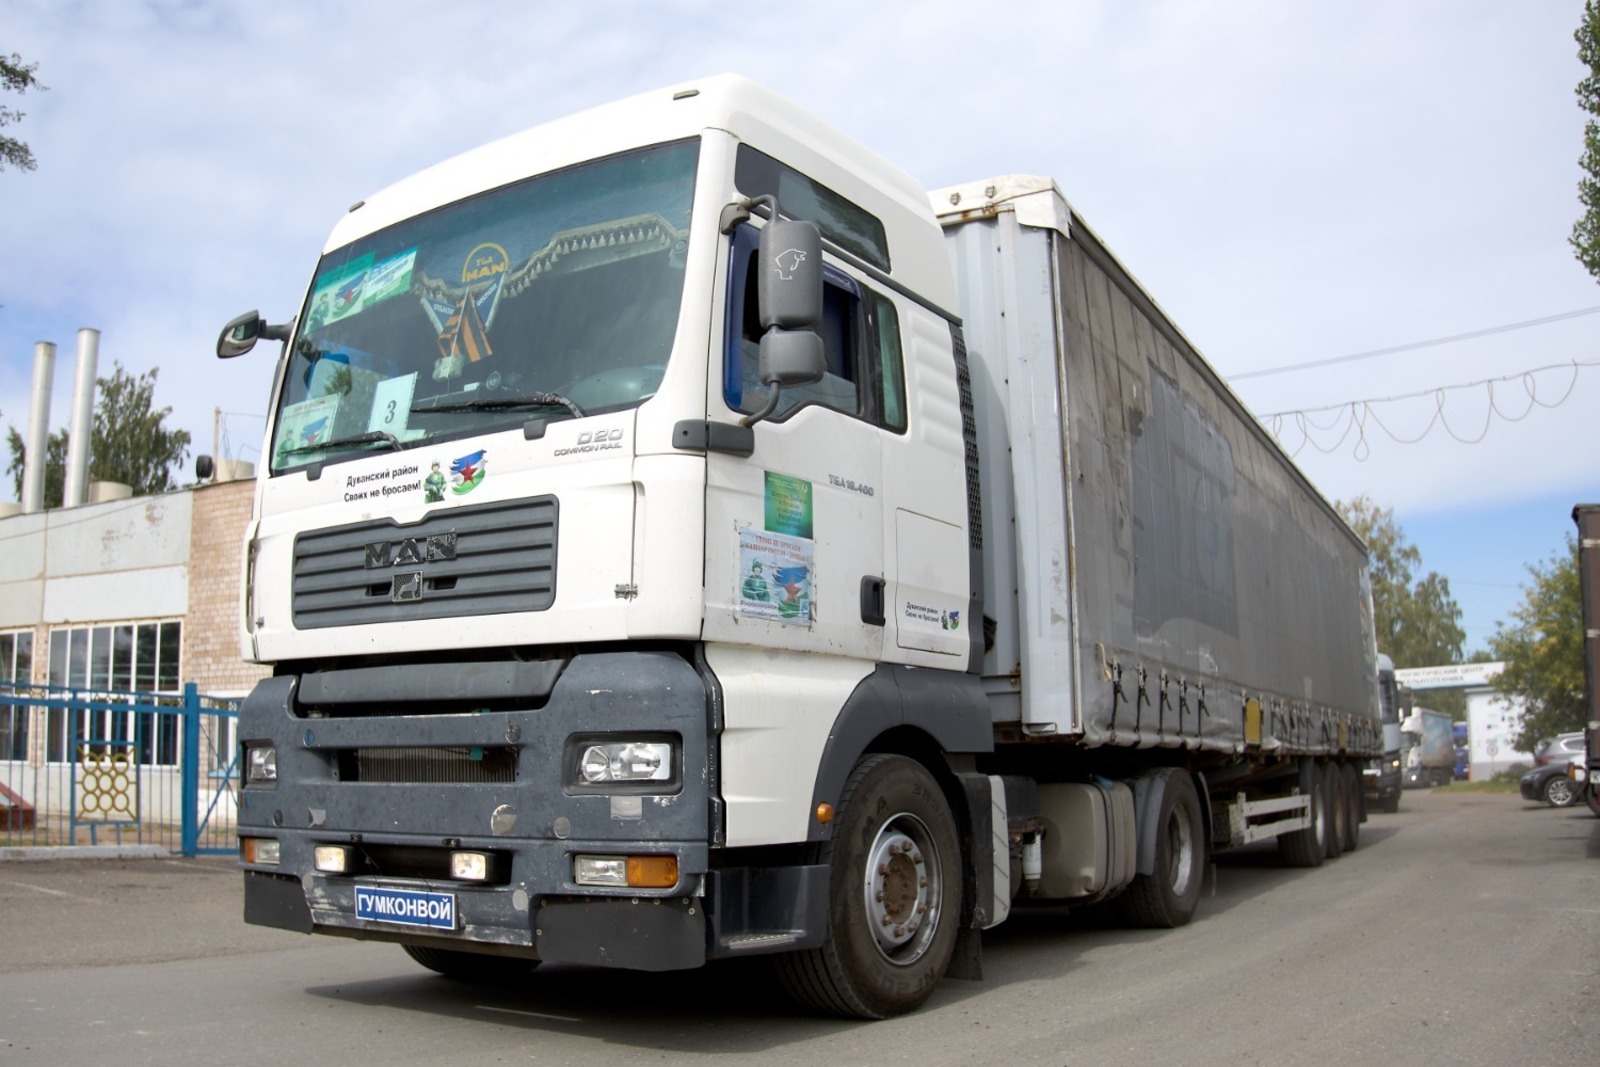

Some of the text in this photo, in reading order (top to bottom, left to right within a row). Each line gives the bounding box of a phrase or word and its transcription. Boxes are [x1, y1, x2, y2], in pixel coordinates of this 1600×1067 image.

[465, 262, 505, 281] MAN
[384, 399, 397, 424] 3
[554, 442, 622, 456] COMMON RAIL
[346, 464, 419, 487] Дуванский район
[344, 480, 422, 502] Своих не бросаем!
[365, 532, 457, 570] MAN
[358, 893, 451, 920] ГУМКОНВОЙ
